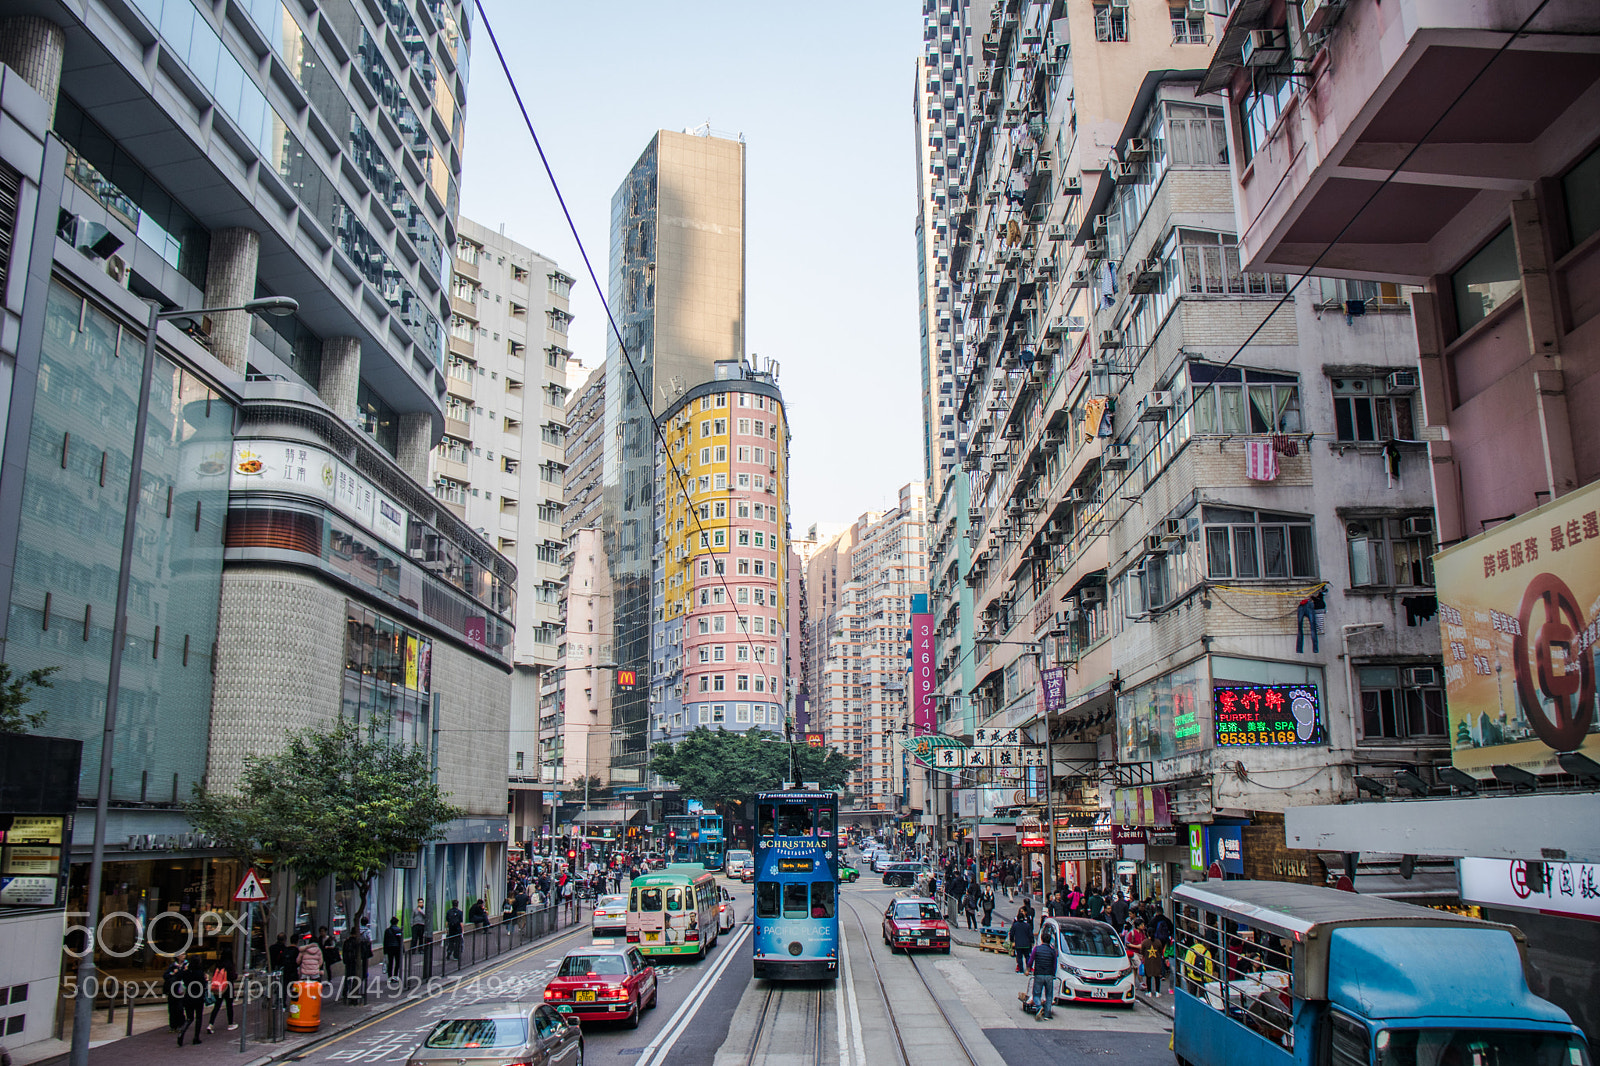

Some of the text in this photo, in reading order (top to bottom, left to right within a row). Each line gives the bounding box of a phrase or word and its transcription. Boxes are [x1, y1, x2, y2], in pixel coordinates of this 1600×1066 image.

[283, 464, 306, 482] 江南
[1483, 536, 1539, 579] 跨境服務
[920, 625, 932, 734] 34609013
[1048, 680, 1061, 698] 沐足
[1220, 689, 1286, 714] 紫竹軒
[1220, 731, 1296, 745] 9533 5169
[766, 840, 827, 849] CHRISTMAS
[763, 926, 831, 936] PACIFIC PLACE
